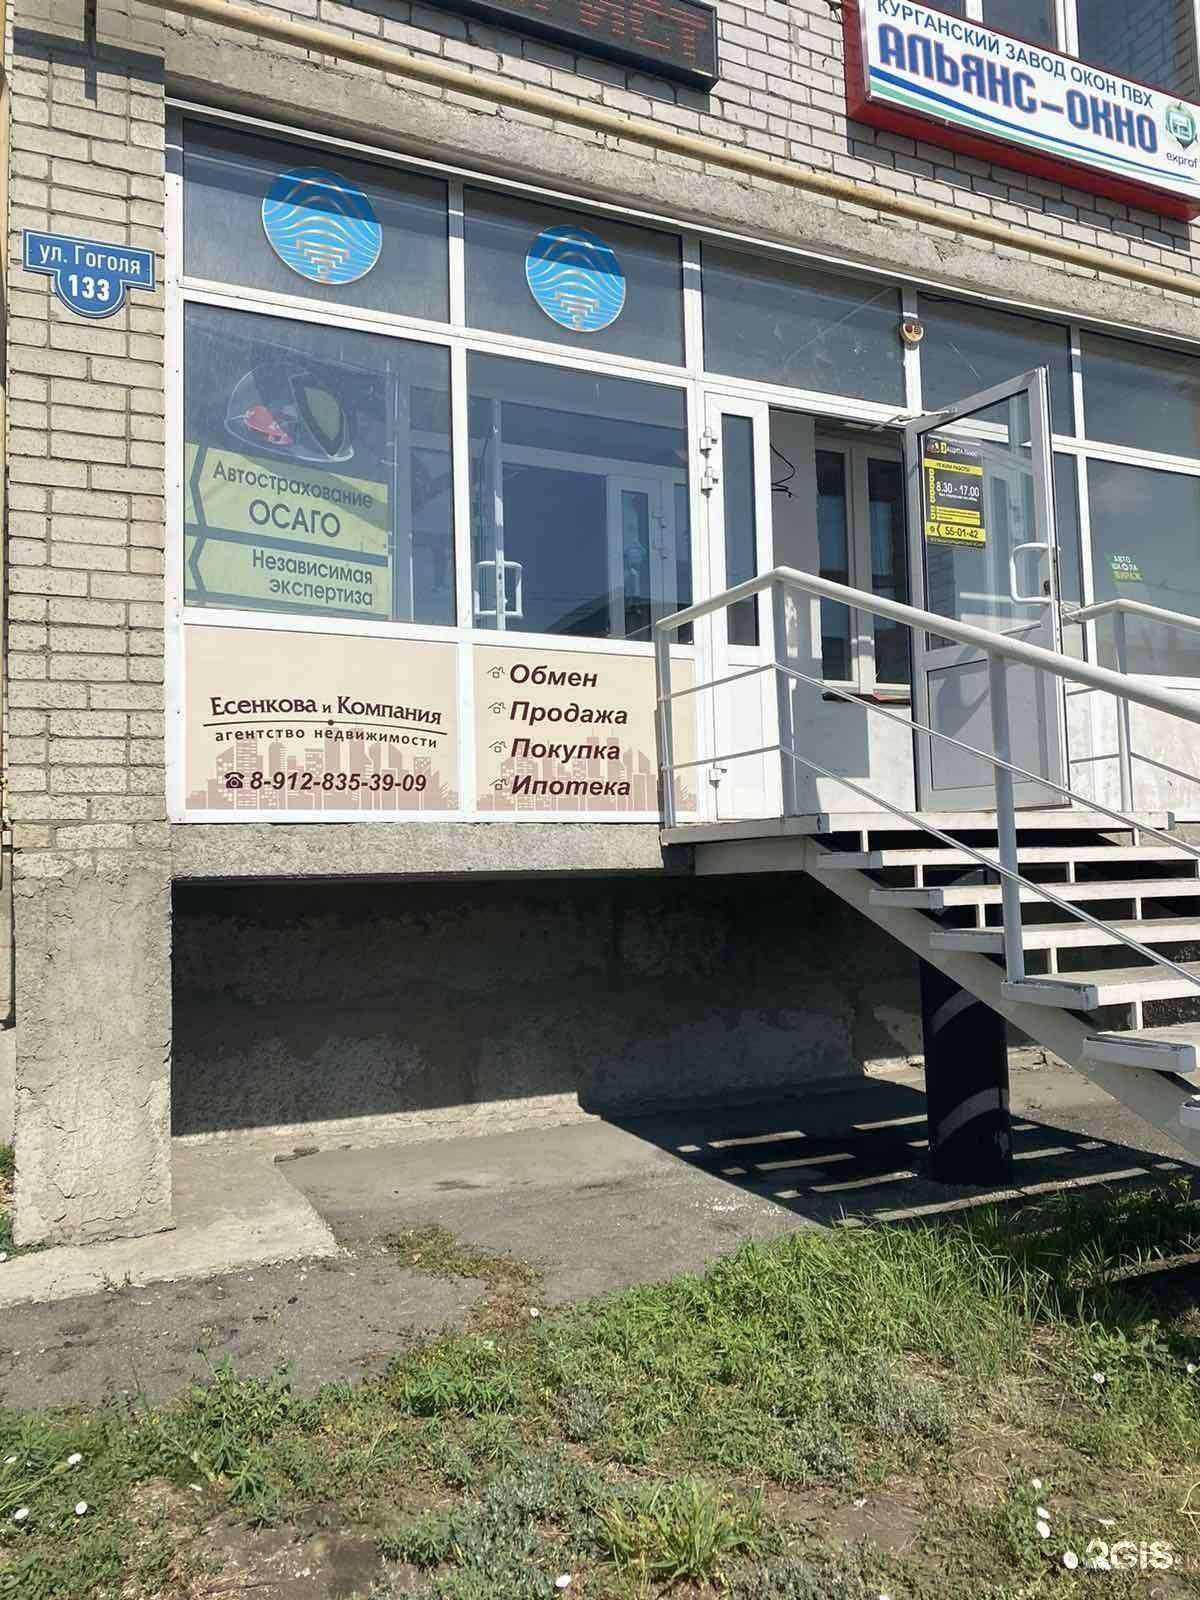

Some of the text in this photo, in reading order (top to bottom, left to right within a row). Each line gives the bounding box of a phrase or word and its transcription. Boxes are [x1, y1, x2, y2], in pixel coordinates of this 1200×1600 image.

[877, 0, 1153, 108] КУРГАНСКИЙ ЗАВОД ОКОН ПВХ
[40, 244, 140, 275] ул. Гоголя
[68, 274, 110, 301] 133
[212, 460, 373, 509] Автострахование
[249, 499, 340, 538] ОСАГО
[252, 549, 373, 585] Независимая
[270, 578, 373, 606] экспертиза
[510, 664, 598, 687] Обмен
[210, 695, 442, 725] Есенкова и Компания
[510, 701, 628, 726] Продажа
[215, 727, 438, 748] агентство недвижимости
[511, 738, 621, 763] Покупка
[250, 772, 427, 791] 8-912-835-39-09
[511, 775, 631, 796] Ипотека
